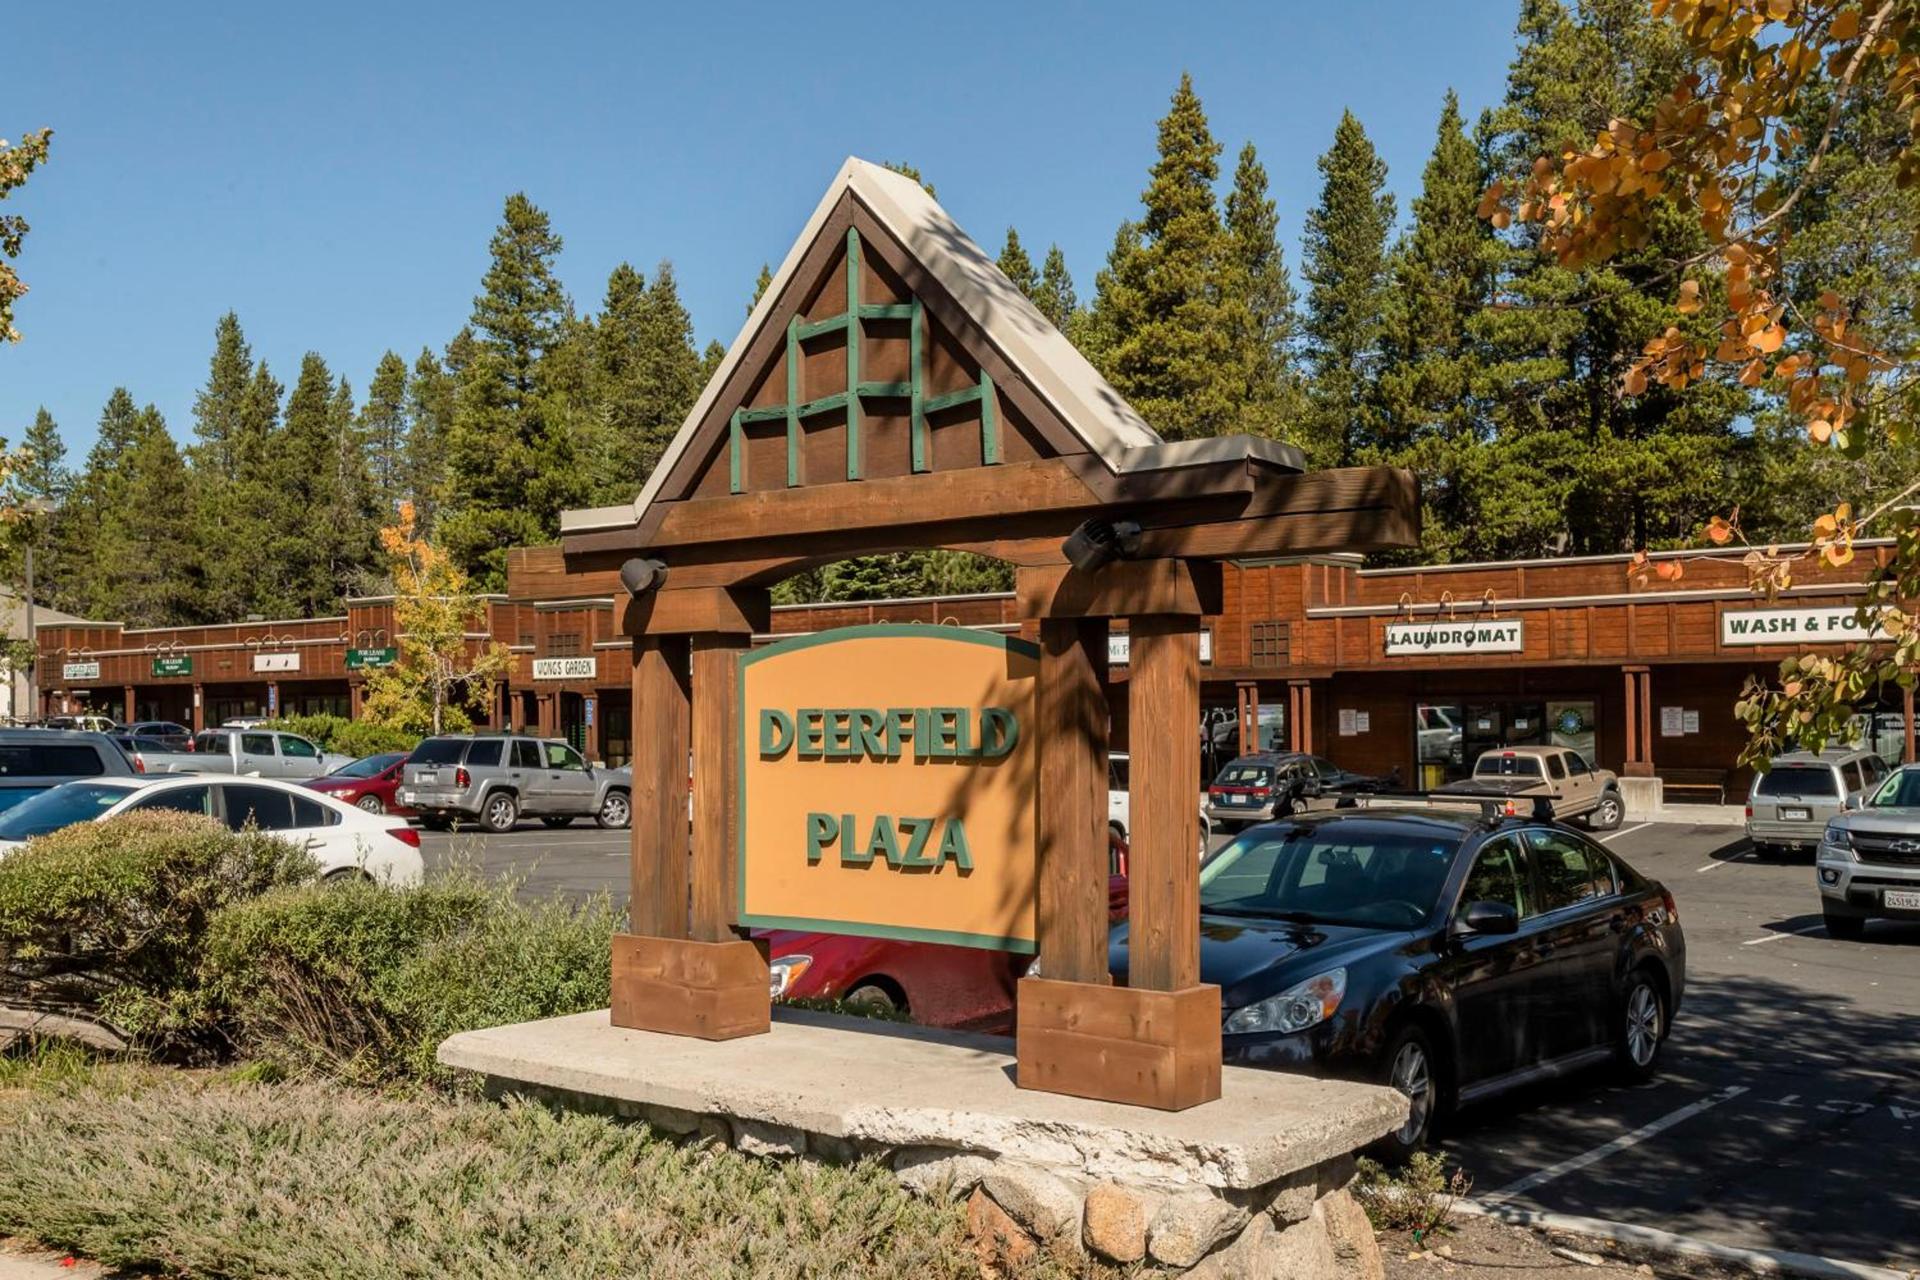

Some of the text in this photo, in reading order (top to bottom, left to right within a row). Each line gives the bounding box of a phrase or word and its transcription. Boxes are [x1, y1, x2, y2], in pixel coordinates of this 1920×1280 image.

[1730, 615, 1866, 634] WASH & FO
[1390, 628, 1518, 646] LAUNDROMAT
[565, 660, 592, 675] GARDEN
[759, 706, 1020, 766] DEERFIELD
[806, 812, 975, 878] PLAZA
